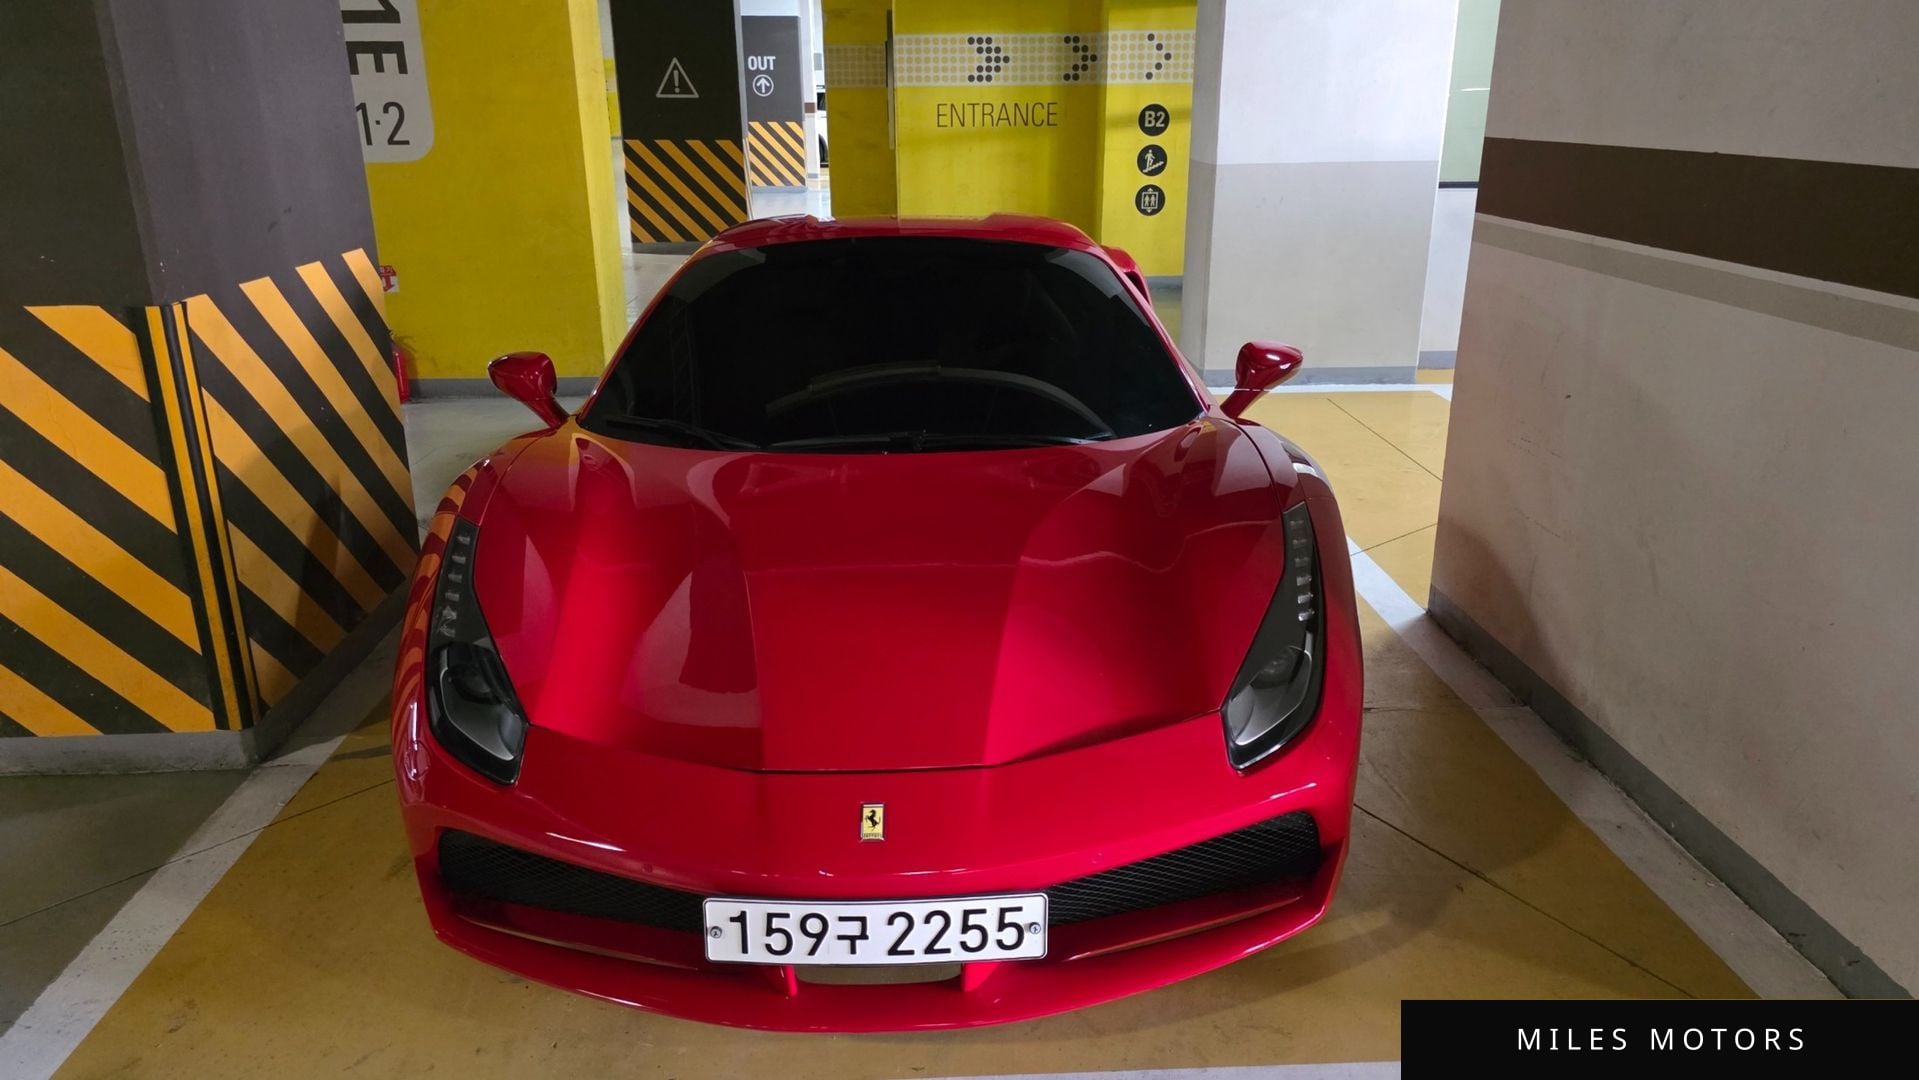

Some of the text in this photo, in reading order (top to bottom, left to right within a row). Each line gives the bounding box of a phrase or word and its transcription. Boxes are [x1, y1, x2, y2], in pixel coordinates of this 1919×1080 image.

[748, 56, 776, 70] OUT
[936, 102, 1058, 127] ENTRANCE
[1144, 111, 1165, 128] B2
[729, 906, 1026, 956] 159구 2255
